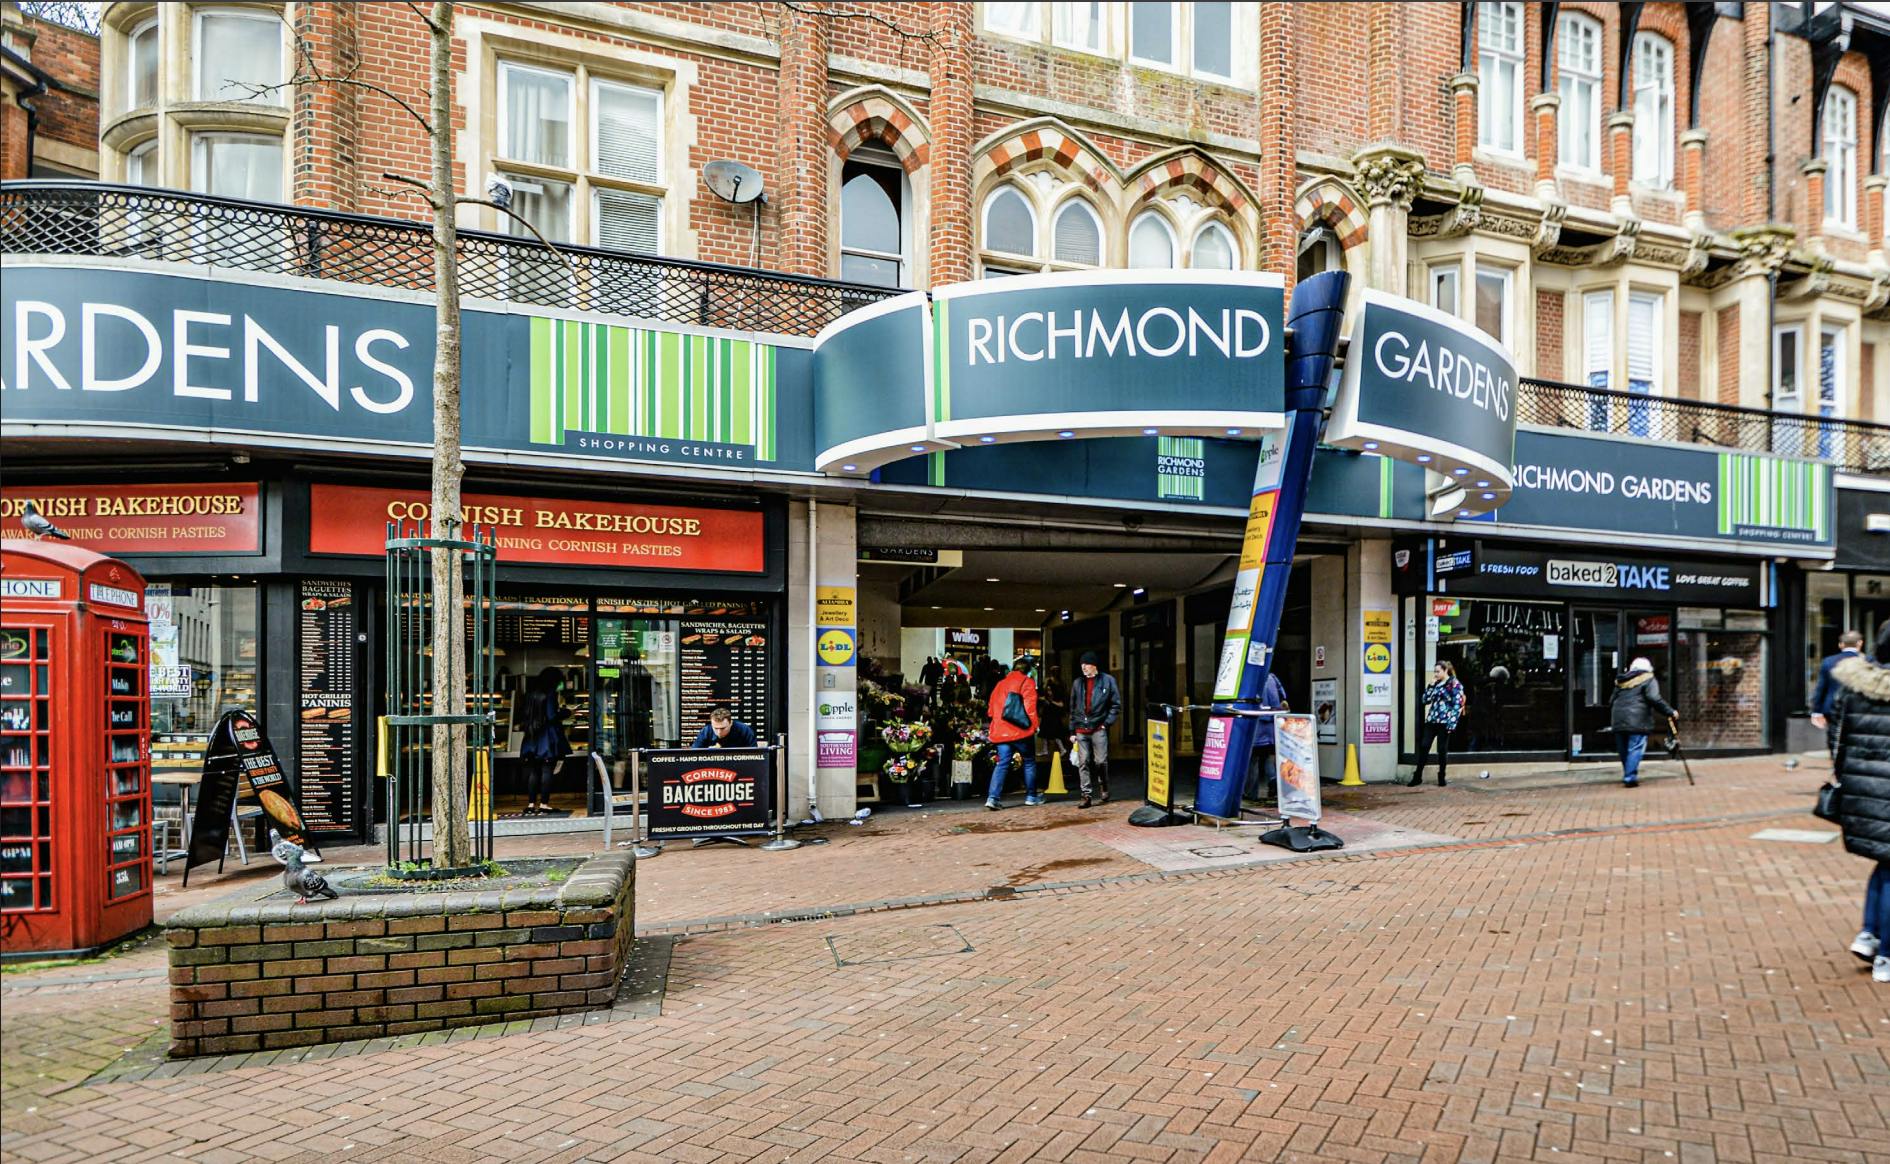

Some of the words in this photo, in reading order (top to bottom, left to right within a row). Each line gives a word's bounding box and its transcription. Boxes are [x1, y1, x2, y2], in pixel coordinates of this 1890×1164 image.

[968, 306, 1270, 366] RICHMOND
[1, 300, 414, 414] RDENS
[1374, 331, 1509, 422] GARDENS
[579, 438, 670, 453] SHOPPING
[681, 446, 743, 460] CENTRE
[1157, 456, 1204, 468] RICHMOND
[1157, 465, 1204, 477] GARDENS
[1511, 464, 1615, 494] RICHMOND
[1621, 475, 1711, 504] GARDENS
[95, 496, 243, 516] BAKEHOUSE
[387, 501, 524, 526] CONISH
[535, 511, 701, 536] BAKEHOUSE
[109, 527, 167, 539] CORNISH
[172, 527, 226, 538] PASTIES
[548, 540, 617, 553] CORNISH
[623, 543, 682, 557] PASTIES
[1487, 564, 1514, 574] FRESH
[1516, 566, 1539, 575] FOOD
[1676, 574, 1696, 584] LOVE
[1697, 575, 1721, 585] GREAT
[1721, 577, 1750, 587] COFFEE
[90, 584, 136, 606] TELEPHONE
[524, 596, 584, 604] TRADITIONAL
[626, 599, 659, 607] PASTIES
[952, 631, 980, 643] wilko
[820, 747, 853, 755] LIVING
[686, 771, 733, 782] CORNISH
[663, 782, 754, 804] BAKEHOUSE
[685, 806, 713, 816] SINCE
[715, 805, 734, 815] 1983
